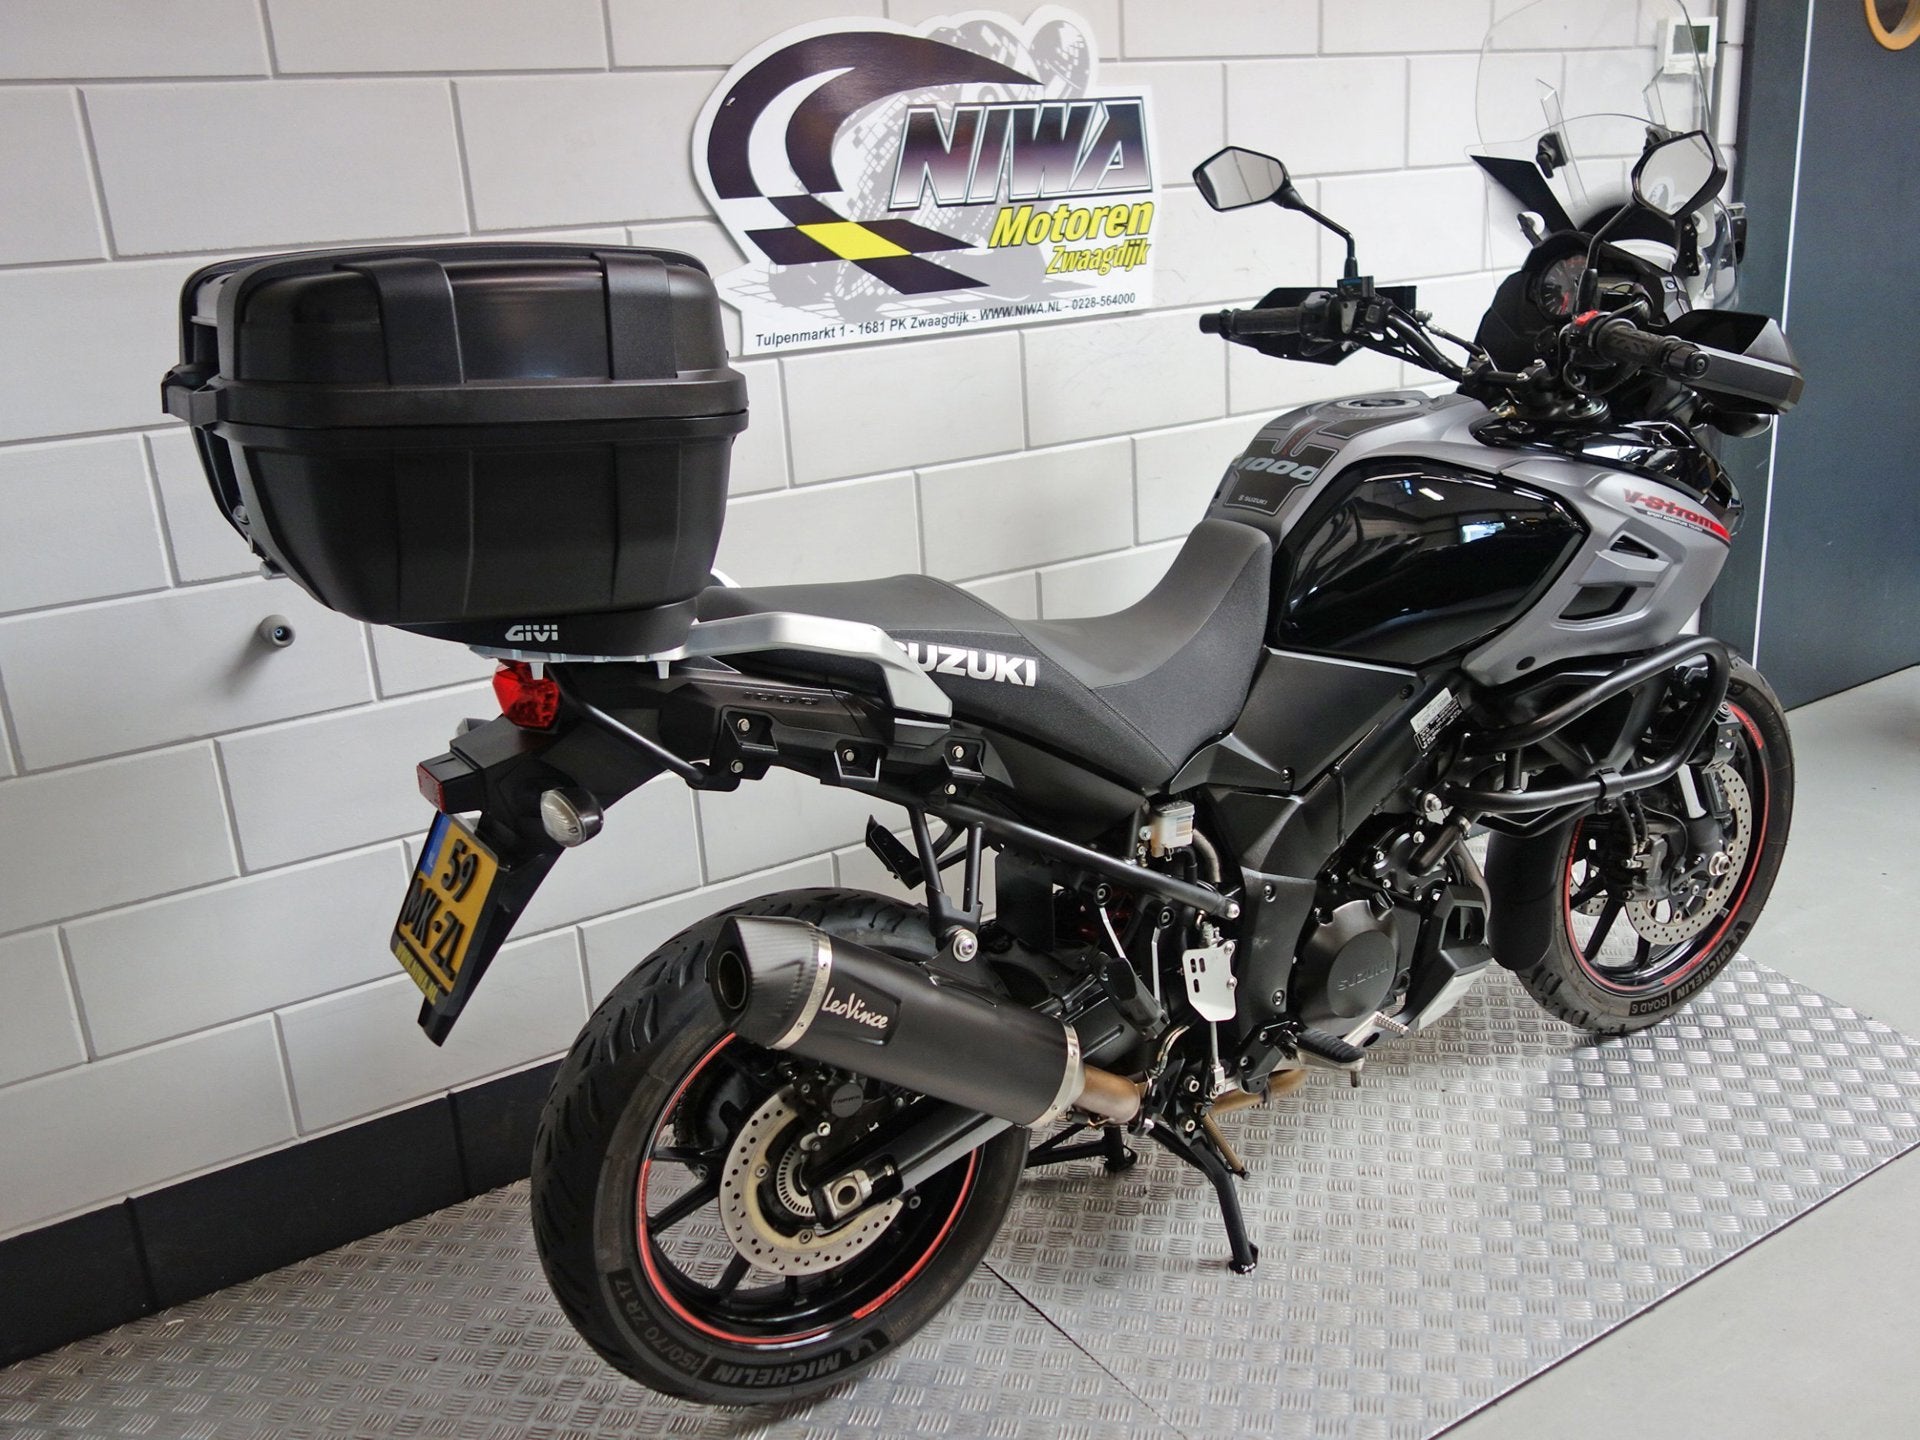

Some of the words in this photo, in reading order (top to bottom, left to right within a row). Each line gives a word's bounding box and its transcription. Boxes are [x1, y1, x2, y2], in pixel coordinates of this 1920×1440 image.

[888, 97, 1152, 212] NIWA
[988, 201, 1154, 248] Motoren
[1046, 238, 1151, 275] Zwaagdijk
[756, 326, 835, 348] Tulpenmarkt
[839, 325, 846, 337] 1
[858, 322, 886, 335] 1681
[890, 318, 907, 332] PK
[911, 312, 969, 330] Zwaagdijk
[980, 302, 1062, 321] WWW.NIWA.NL
[1071, 293, 1136, 311] 0228-564000
[1236, 456, 1320, 482] 1000
[1623, 488, 1713, 530] V-Strom
[504, 624, 559, 642] GIVI
[441, 838, 479, 903] 59
[1676, 943, 1732, 1000] MICHELIN
[821, 987, 889, 1029] LeoVince
[1631, 1003, 1638, 1014] 6
[1641, 995, 1668, 1012] ROAD
[615, 1279, 630, 1293] 17
[625, 1302, 650, 1323] ZR
[647, 1327, 699, 1375] 150/70
[712, 1352, 841, 1386] MICHELIN
